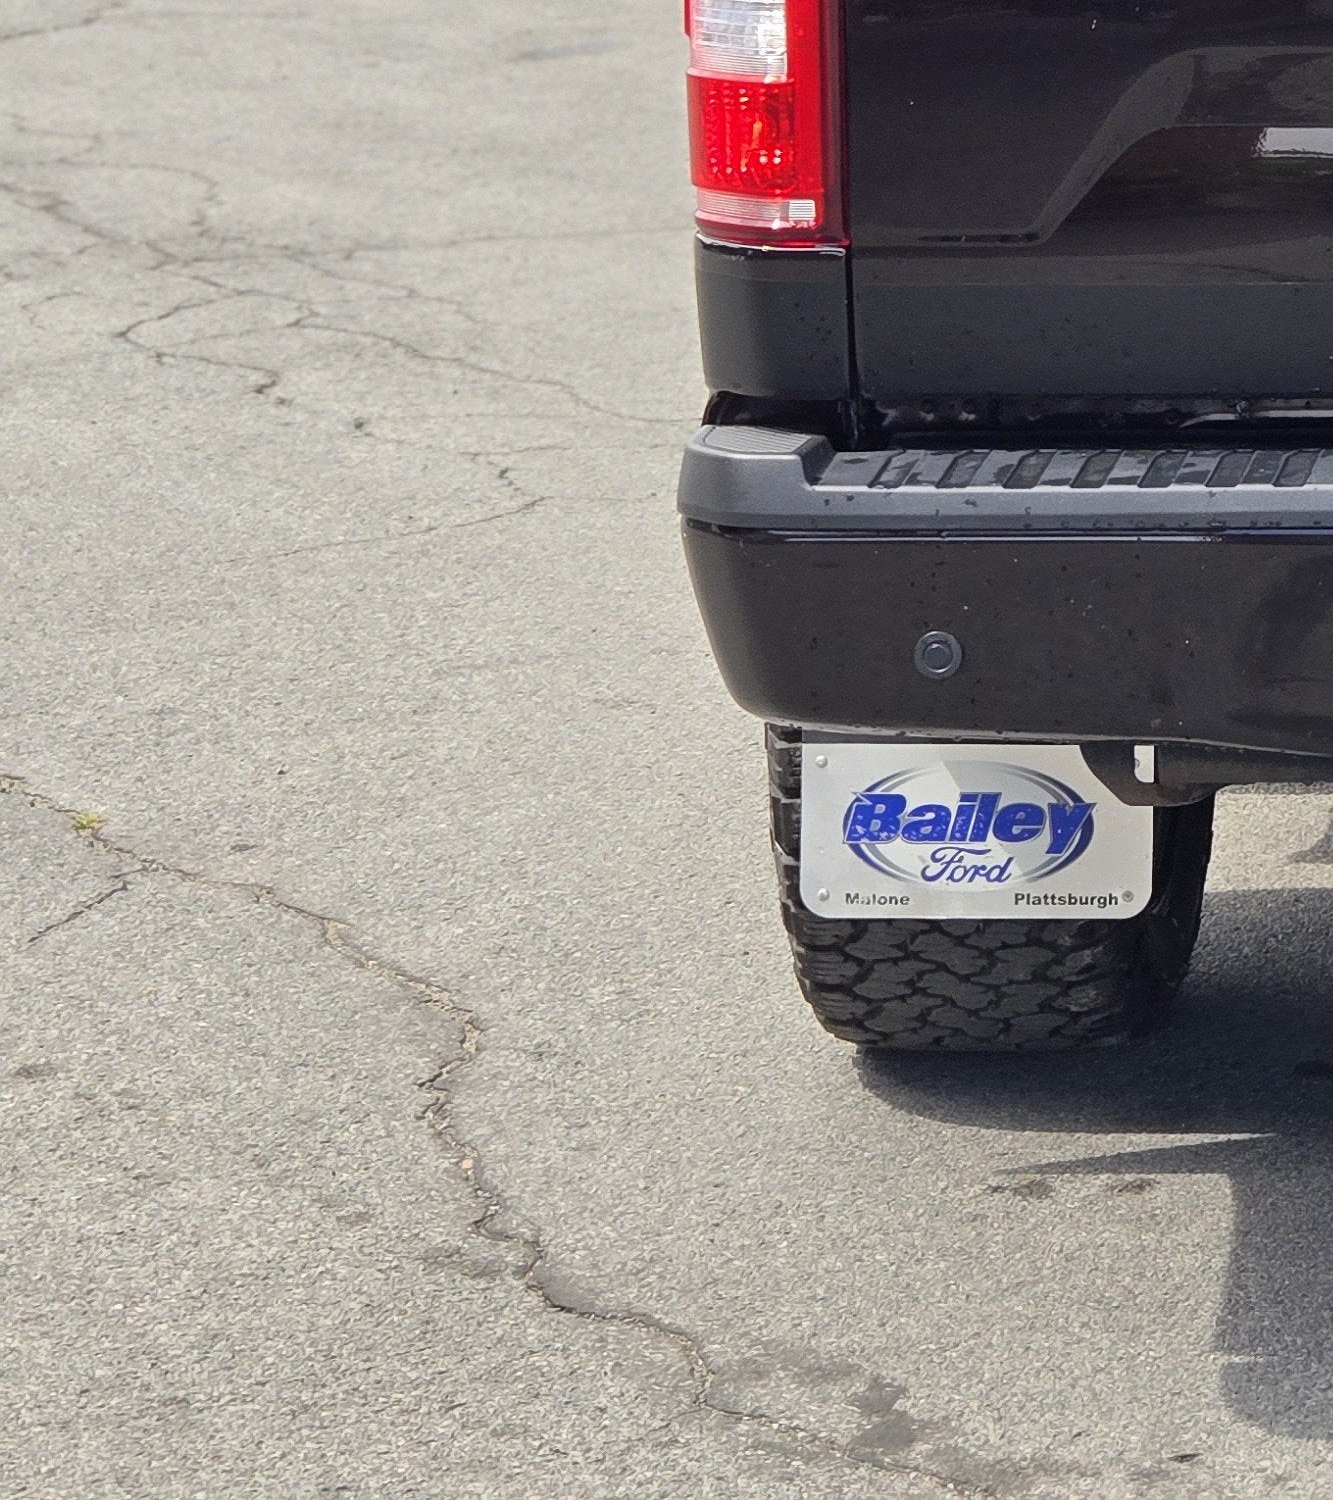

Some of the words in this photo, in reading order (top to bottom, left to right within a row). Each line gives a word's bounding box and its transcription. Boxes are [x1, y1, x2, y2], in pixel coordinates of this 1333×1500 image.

[843, 790, 1096, 855] Bailey
[920, 846, 1015, 883] Ford
[845, 892, 911, 906] Malone
[1014, 892, 1120, 909] Plattsburgh
